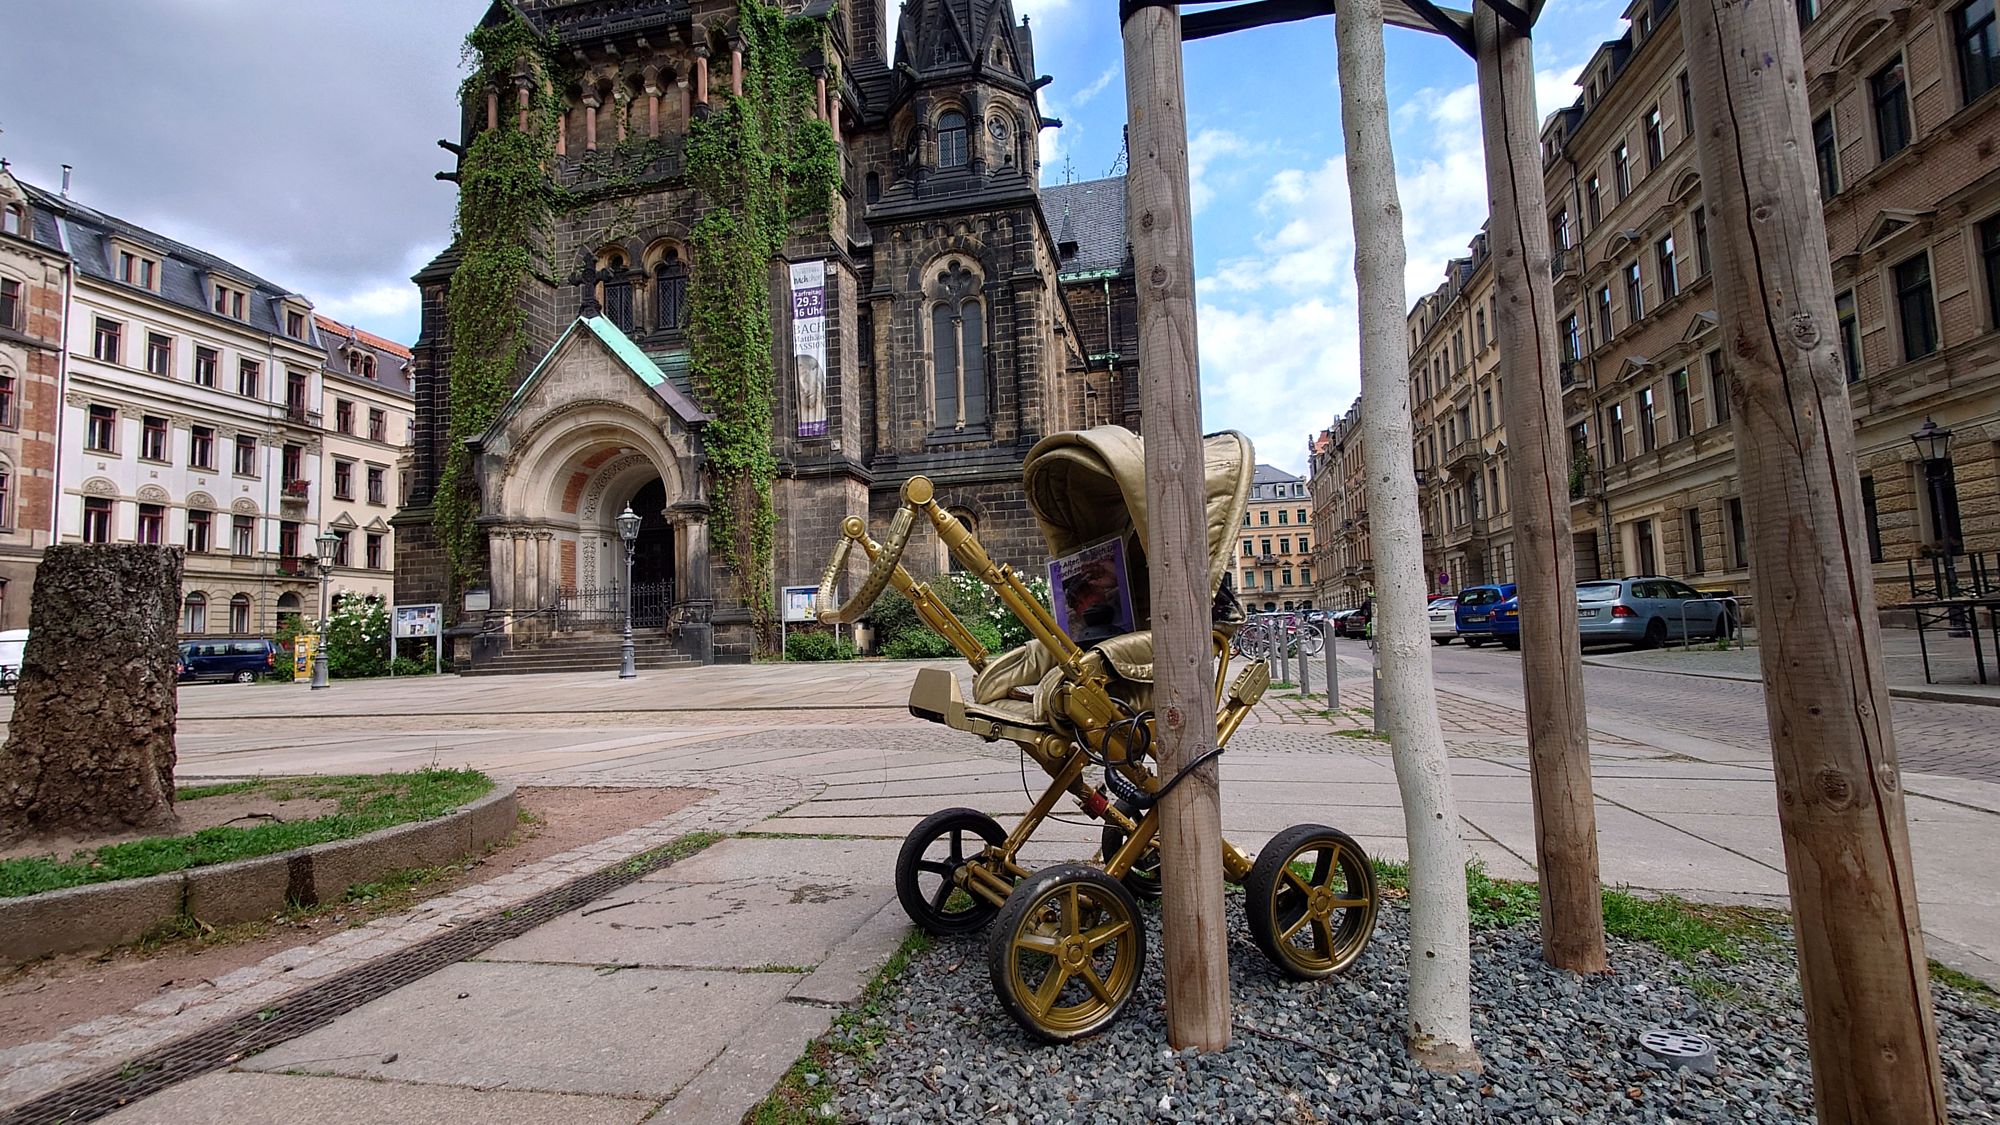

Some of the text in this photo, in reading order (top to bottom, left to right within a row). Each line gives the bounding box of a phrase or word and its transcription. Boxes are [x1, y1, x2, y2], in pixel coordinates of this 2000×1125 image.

[796, 296, 821, 307] 29.3.
[794, 306, 823, 317] 16 Uhr
[793, 322, 825, 335] BACH
